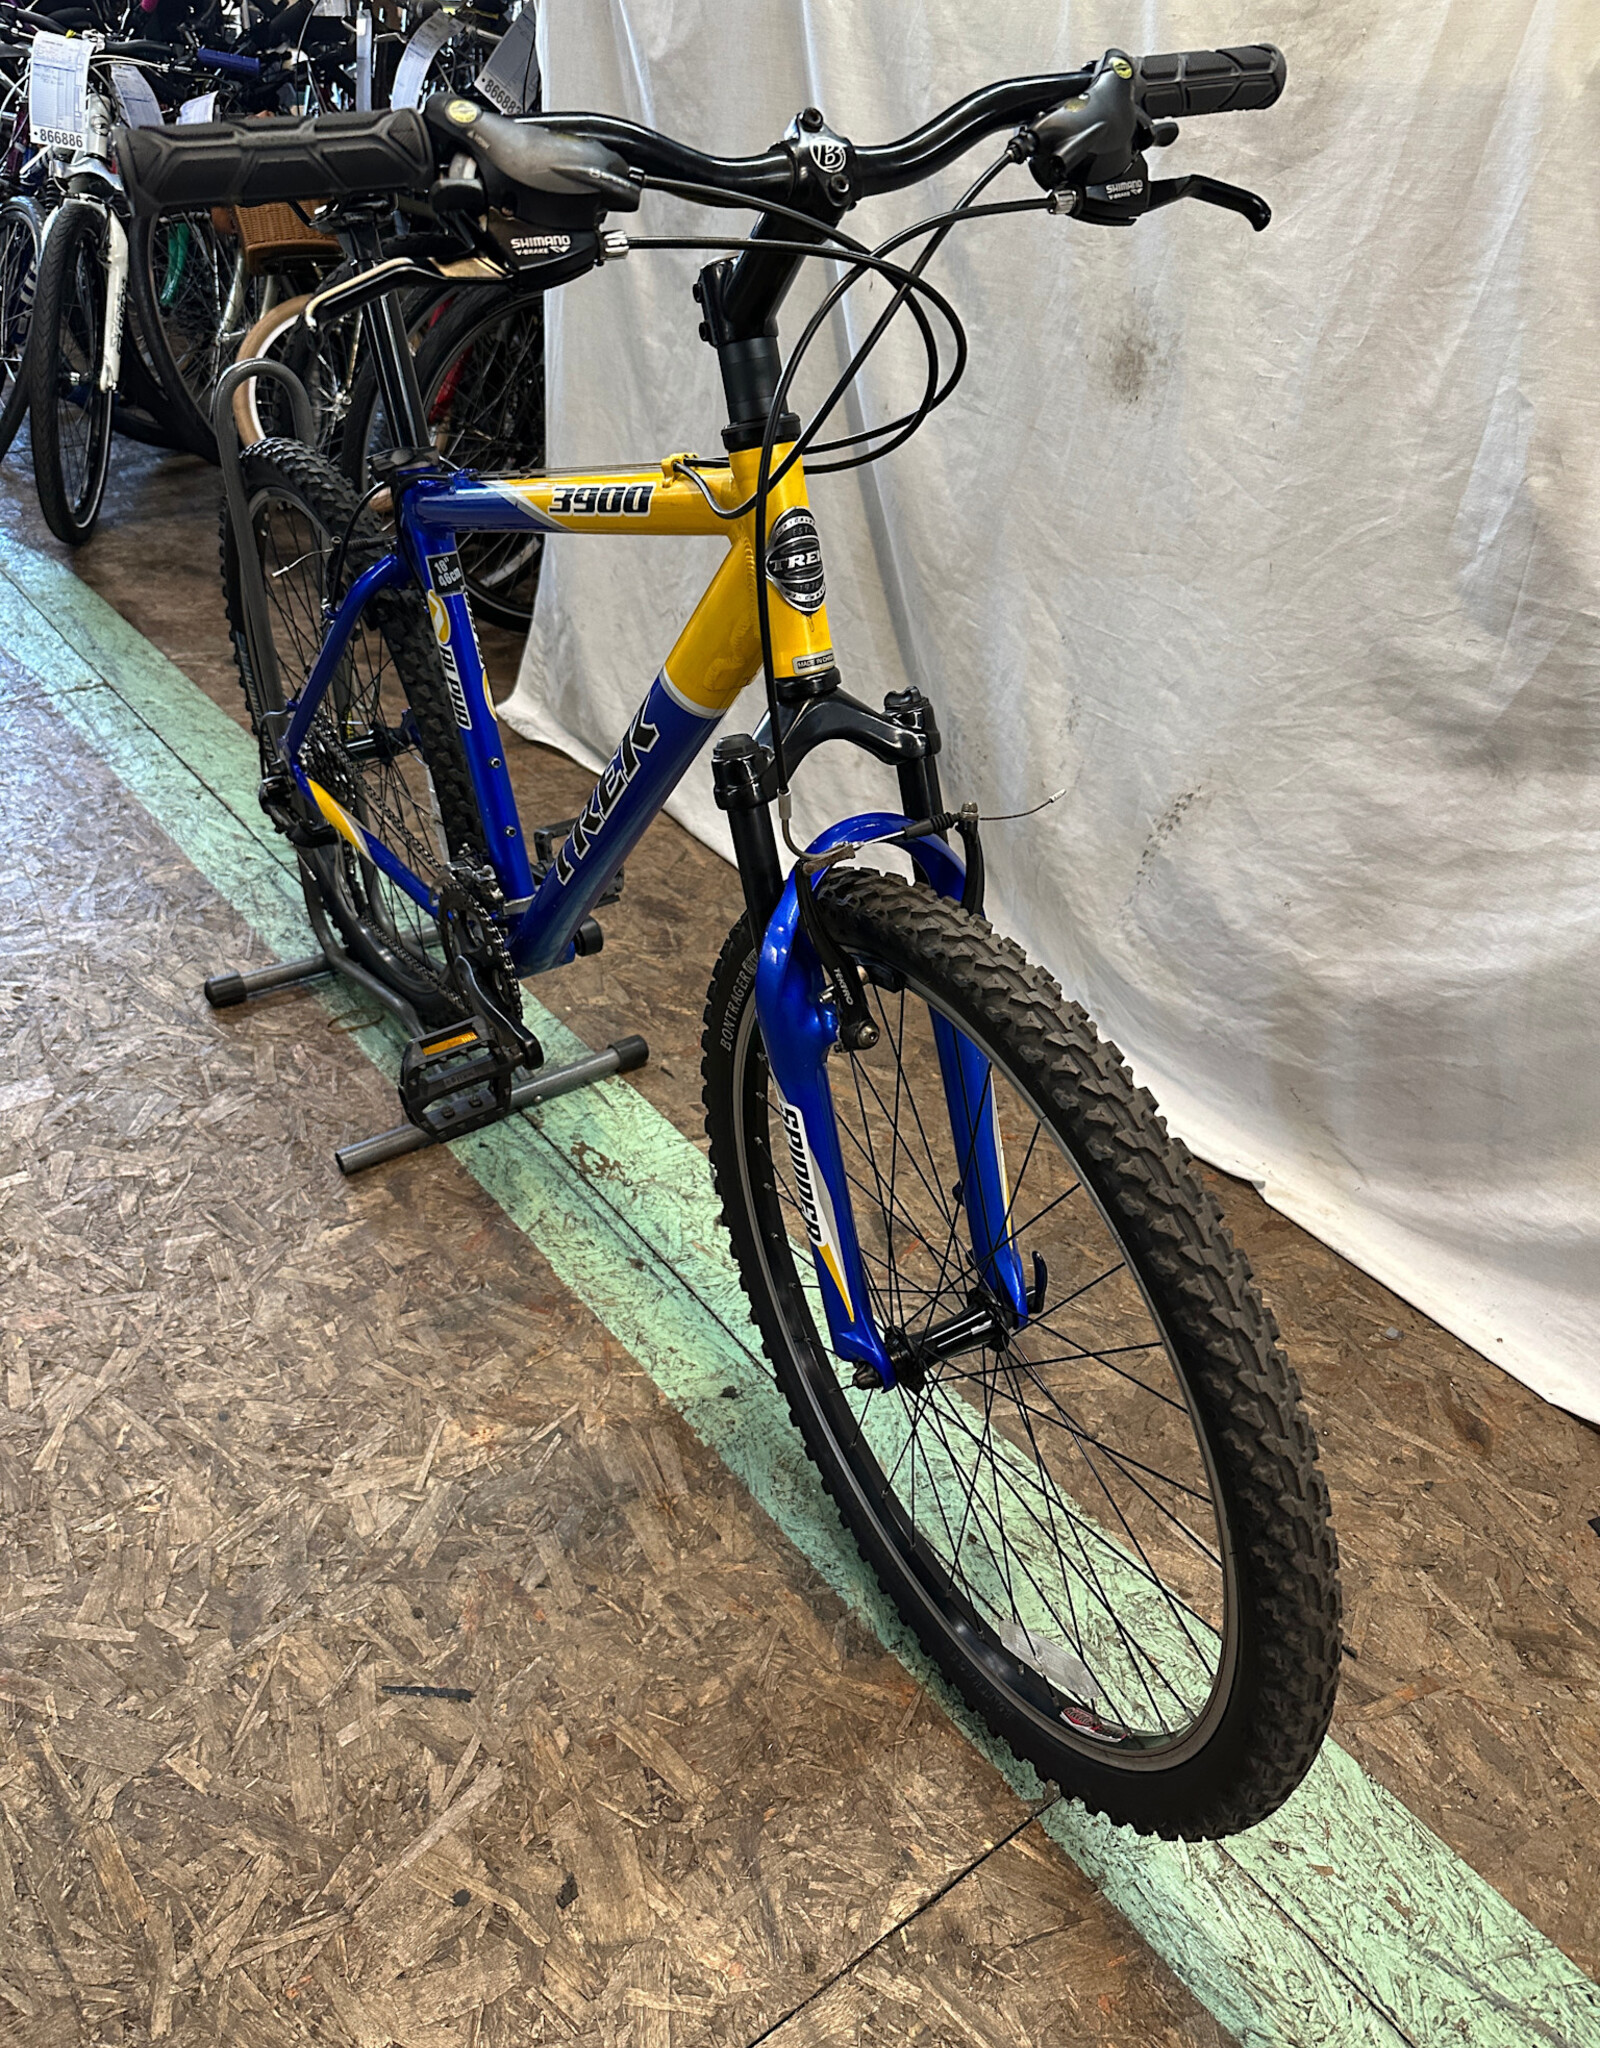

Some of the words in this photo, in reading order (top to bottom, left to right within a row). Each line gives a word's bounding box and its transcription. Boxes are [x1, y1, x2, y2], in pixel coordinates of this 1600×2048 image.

[39, 128, 84, 148] 866886
[1106, 179, 1144, 194] SHIMANO
[510, 234, 571, 249] SHIMANO
[514, 247, 549, 256] V-BRAKE
[548, 483, 655, 514] 3900
[434, 556, 450, 574] 18"
[438, 567, 462, 588] 46cm
[797, 658, 815, 668] MADE
[555, 688, 660, 886] TREK
[833, 966, 854, 1006] TEKTRO
[720, 969, 750, 1053] BONTRAGER
[781, 1105, 823, 1243] SPINNER
